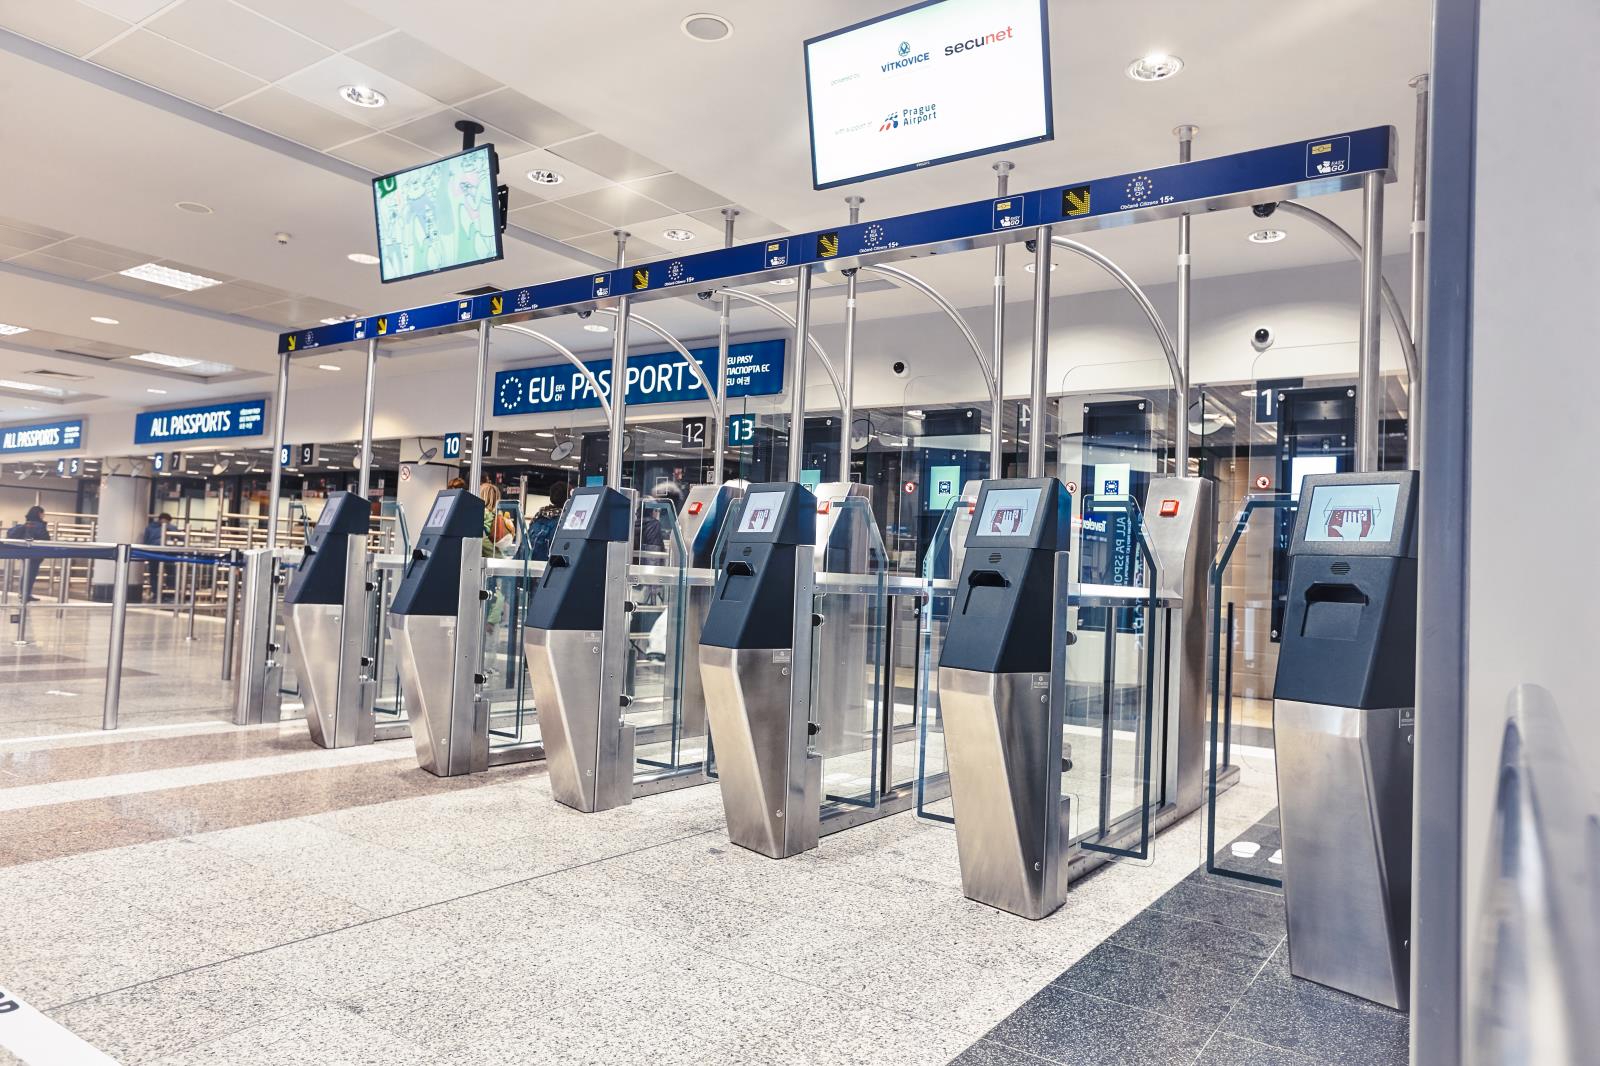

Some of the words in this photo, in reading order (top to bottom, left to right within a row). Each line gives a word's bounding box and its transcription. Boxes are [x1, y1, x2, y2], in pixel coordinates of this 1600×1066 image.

[944, 25, 1013, 56] secunet
[903, 103, 936, 118] Prague
[903, 111, 937, 126] Airport
[1331, 164, 1344, 172] GO
[1159, 195, 1174, 204] 15+
[888, 241, 899, 249] 15+
[727, 356, 736, 365] EU
[736, 354, 754, 364] PASY
[726, 364, 761, 376] ПАСПОРТА
[571, 360, 703, 400] PASPORTS
[726, 378, 735, 386] EU
[528, 376, 555, 404] EU
[555, 384, 565, 392] EEA
[555, 393, 562, 401] CH
[150, 416, 169, 437] ALL
[170, 410, 231, 436] PASSPORTS
[732, 419, 753, 440] 13
[3, 432, 18, 449] ALL
[18, 427, 60, 447] PASSPORTS
[685, 422, 704, 443] 12
[446, 437, 460, 455] 10
[155, 455, 163, 470] 6
[173, 455, 179, 468] 7
[281, 447, 288, 464] 8
[303, 447, 311, 463] 9
[57, 460, 64, 473] 4
[71, 460, 78, 473] 5
